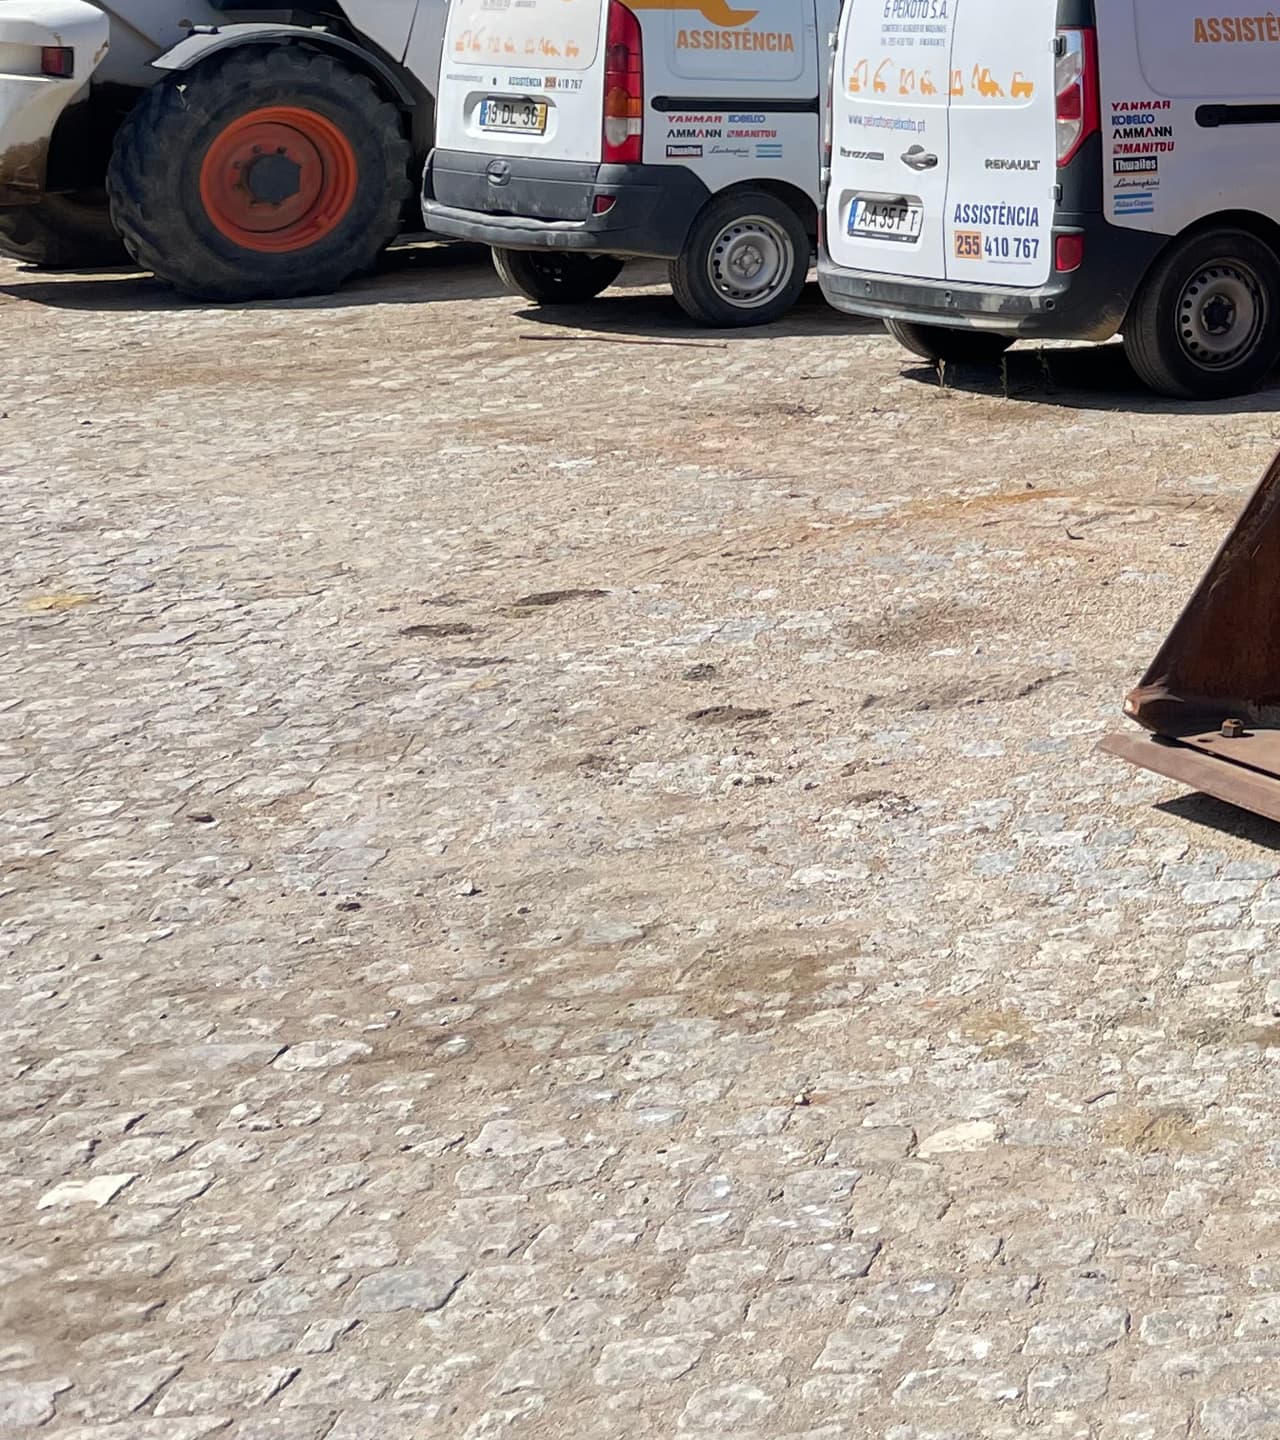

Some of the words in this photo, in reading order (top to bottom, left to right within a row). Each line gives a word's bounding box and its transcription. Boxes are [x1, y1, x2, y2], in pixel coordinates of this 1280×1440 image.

[892, 0, 929, 19] PEIXOTO
[676, 27, 795, 53] ASSISTÊNCIA
[1111, 101, 1171, 111] YANMAR
[501, 104, 517, 125] DL
[522, 106, 539, 126] 36
[667, 115, 722, 123] YANMAR
[1111, 114, 1155, 126] KOBELCO
[667, 129, 722, 138] AMMANN
[1113, 126, 1173, 139] AMMANN
[1123, 141, 1175, 155] MANITOU
[985, 159, 1041, 170] RENAULT
[858, 205, 877, 227] AA
[880, 206, 897, 229] 35
[954, 201, 1039, 227] ASSISTÊNCIA
[957, 235, 980, 256] 255
[985, 236, 1009, 257] 410
[1013, 237, 1040, 259] 767
